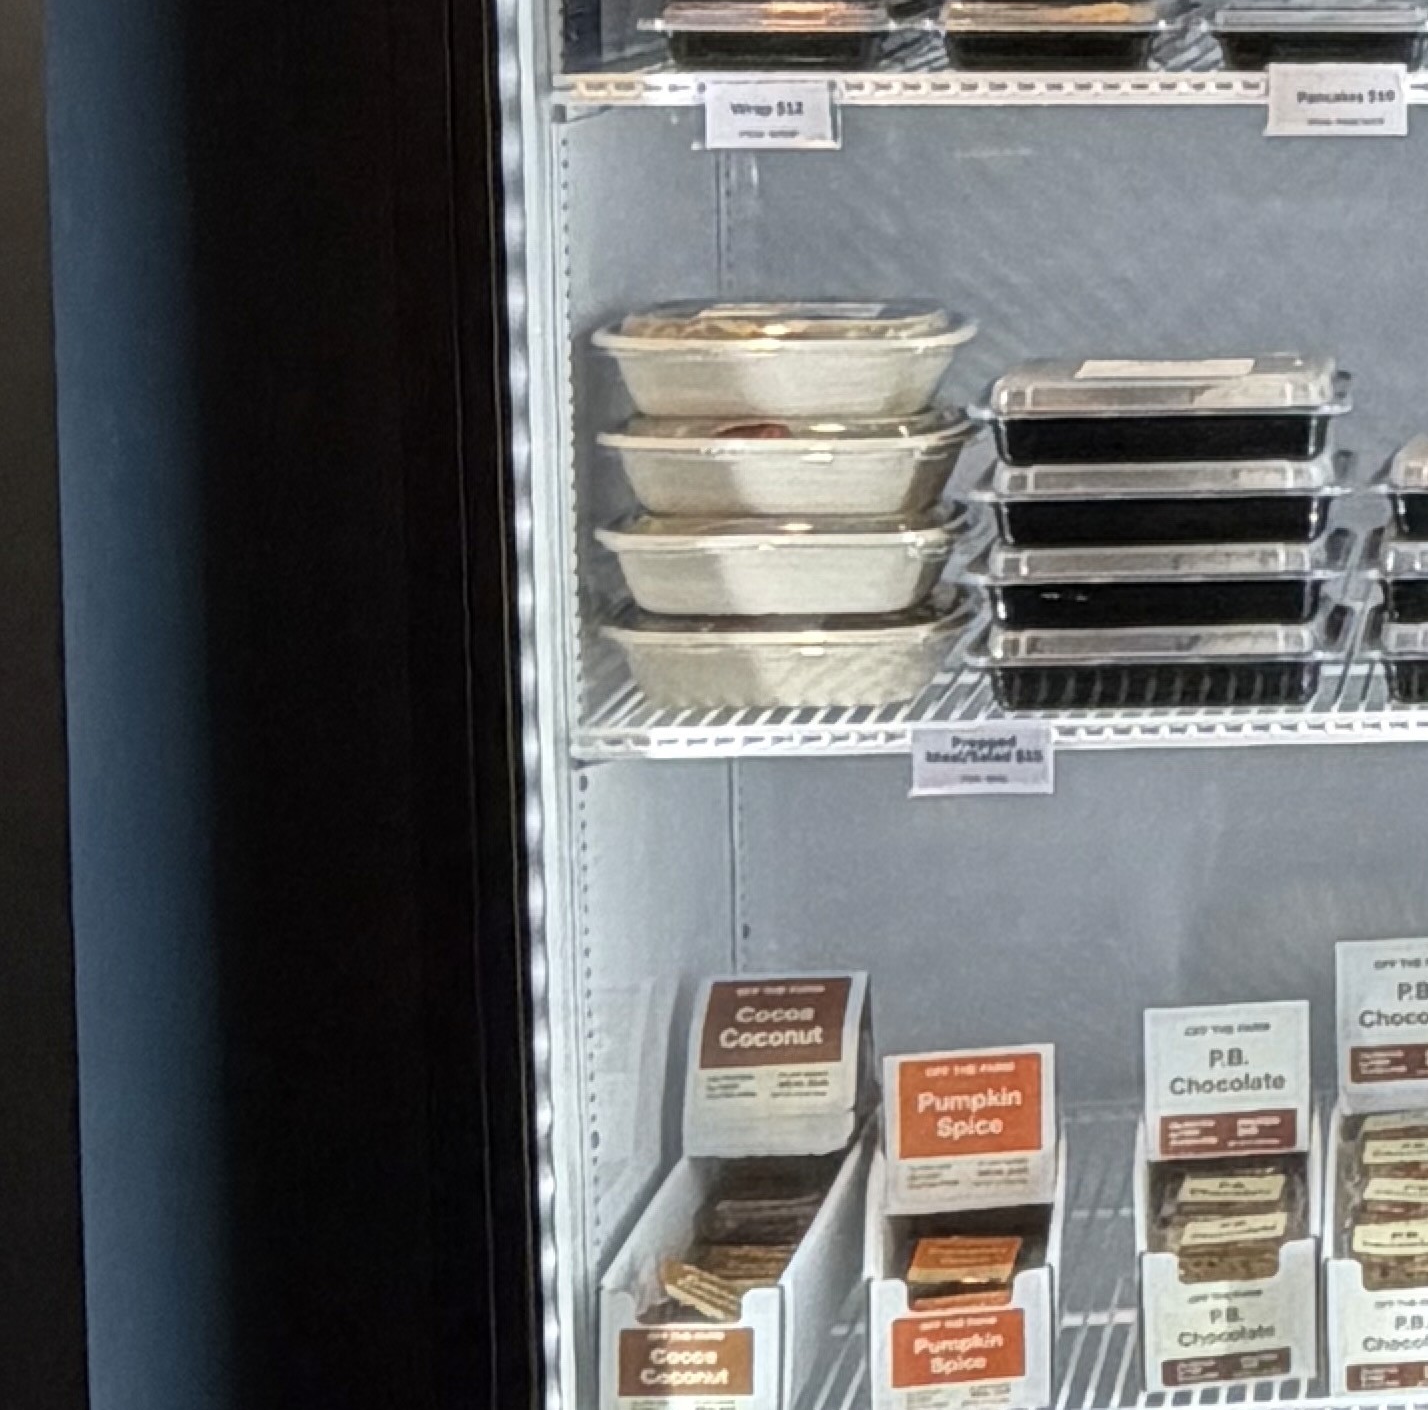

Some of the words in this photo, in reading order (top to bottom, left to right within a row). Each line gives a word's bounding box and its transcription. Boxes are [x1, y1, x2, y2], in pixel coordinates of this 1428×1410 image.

[735, 1005, 815, 1023] Cocoa
[719, 1025, 824, 1049] Coconut
[1168, 1071, 1286, 1096] Chocolate
[917, 1086, 1021, 1114] Pumpkin
[936, 1115, 1004, 1141] Spice
[914, 1333, 1004, 1355] Pumpkin
[1178, 1324, 1276, 1347] Chocolate
[650, 1348, 718, 1365] Cocoa
[931, 1355, 988, 1375] Spice
[640, 1367, 730, 1386] Coconut
